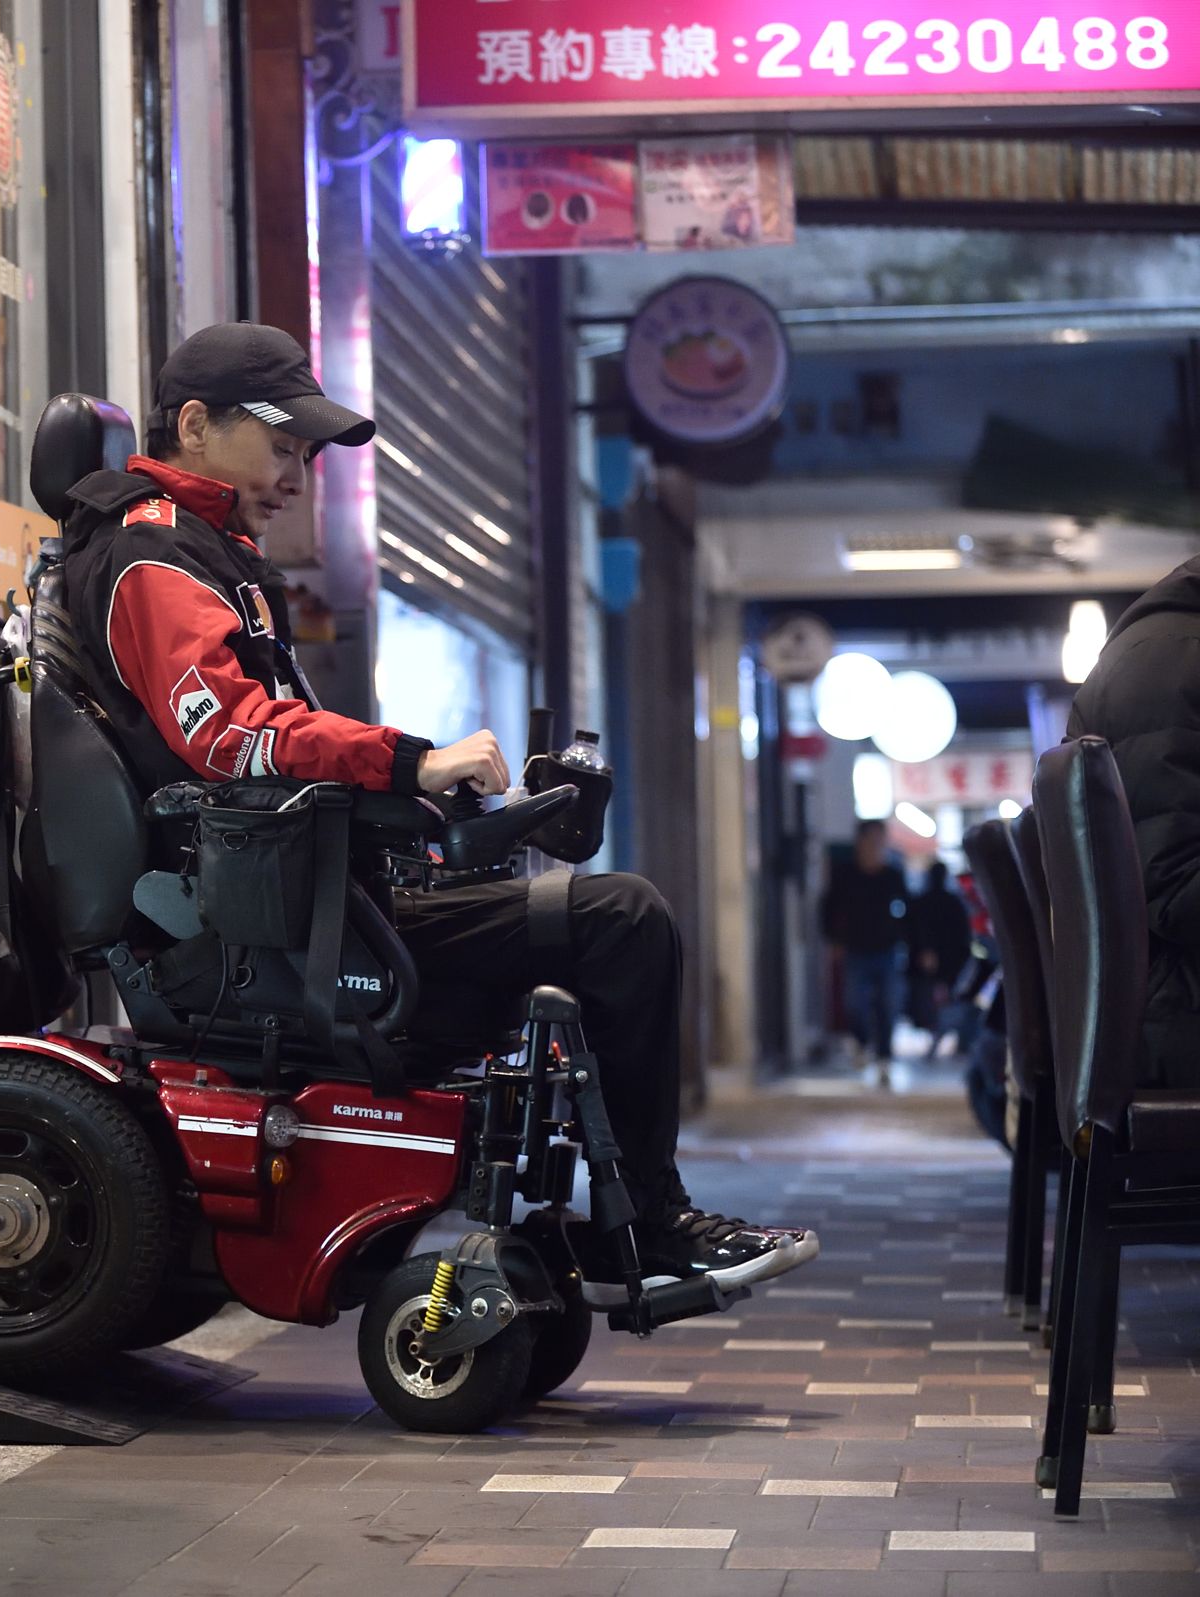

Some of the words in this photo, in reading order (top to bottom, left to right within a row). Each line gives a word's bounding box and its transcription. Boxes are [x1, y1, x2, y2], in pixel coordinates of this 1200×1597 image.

[181, 697, 214, 737] Marlboro
[232, 734, 252, 778] vodafone
[336, 974, 381, 992] rma
